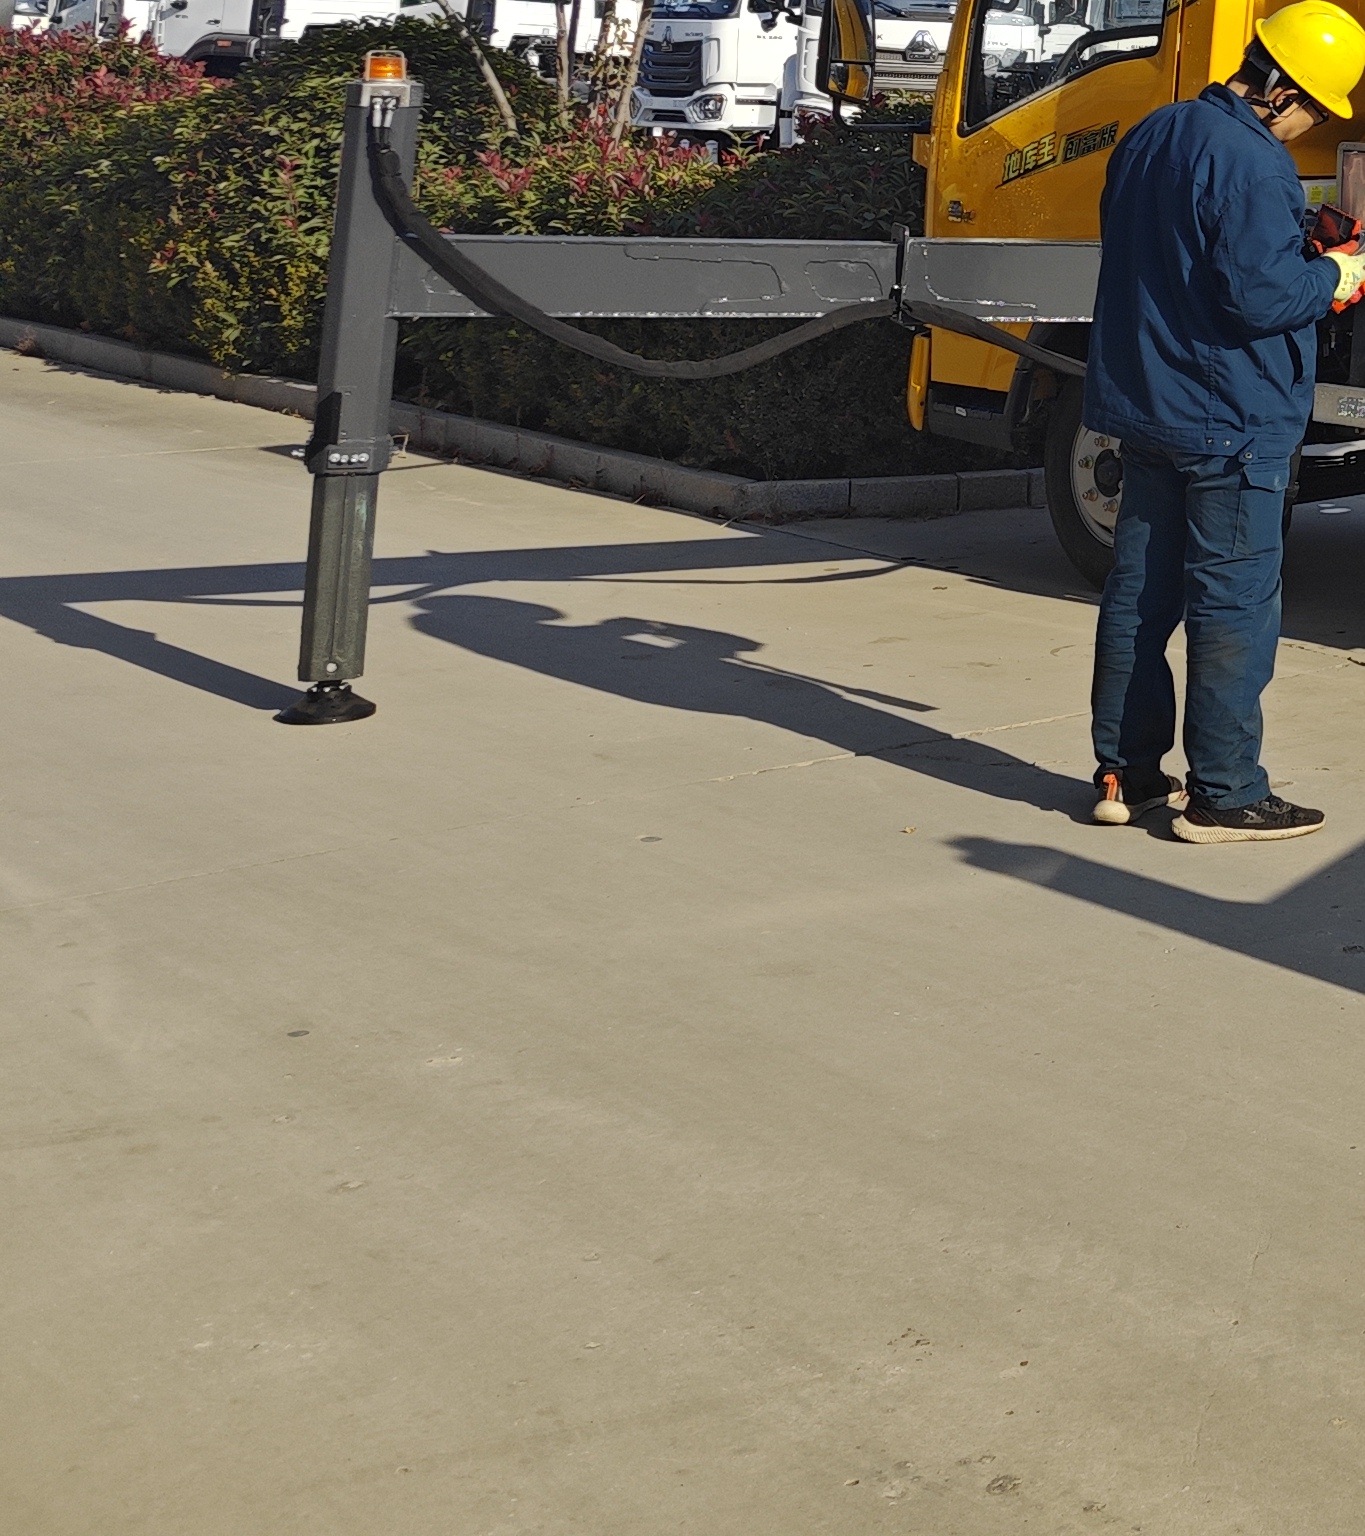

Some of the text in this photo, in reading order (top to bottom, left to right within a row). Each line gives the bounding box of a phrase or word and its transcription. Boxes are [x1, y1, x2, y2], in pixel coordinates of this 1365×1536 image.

[1002, 120, 1120, 183] 地库王 创富版
